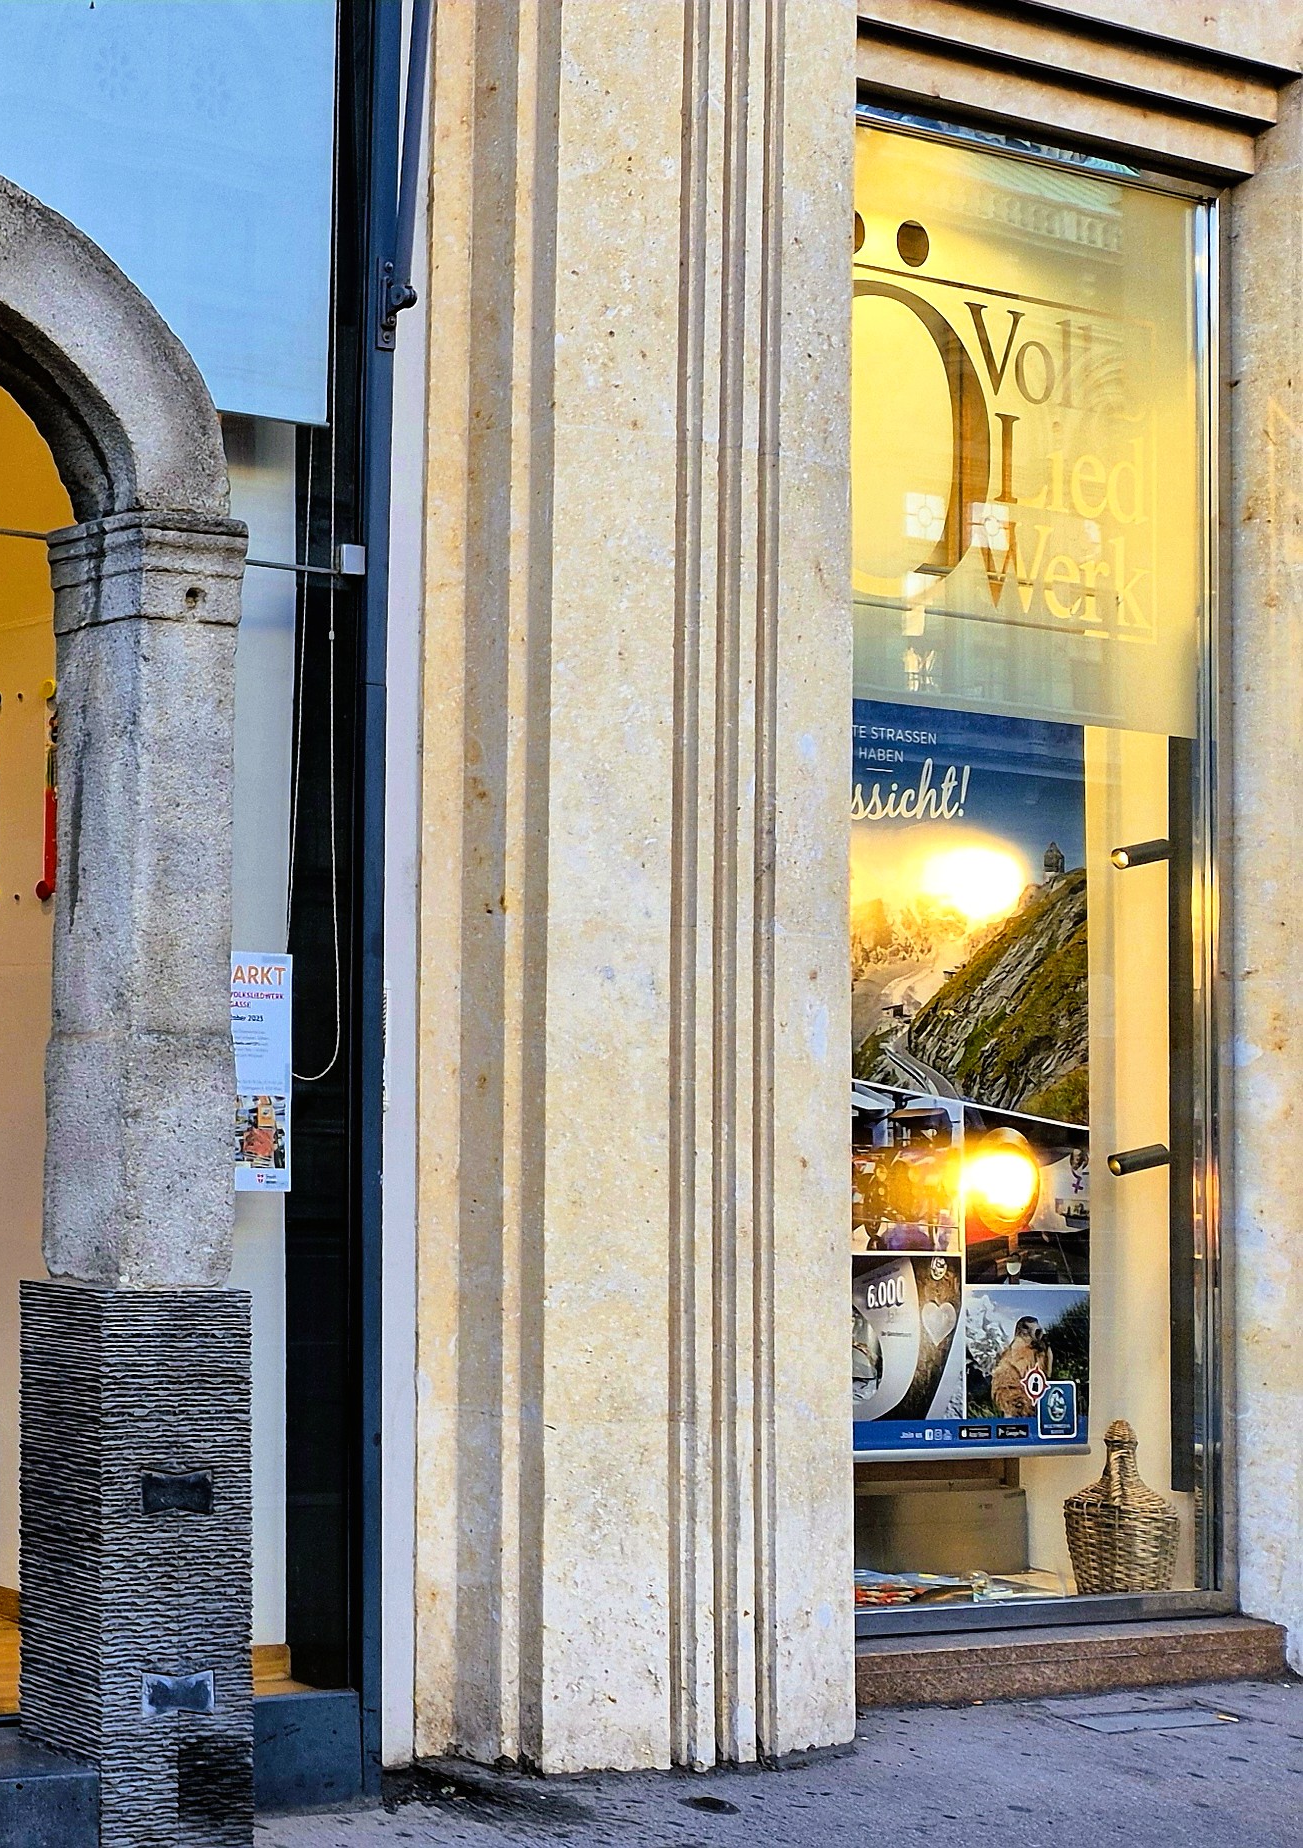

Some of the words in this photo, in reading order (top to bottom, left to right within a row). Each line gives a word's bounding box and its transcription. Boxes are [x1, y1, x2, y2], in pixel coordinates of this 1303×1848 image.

[993, 410, 1149, 526] Lied
[975, 515, 1155, 628] Werk
[859, 748, 904, 763] HABEN
[870, 727, 937, 746] STRASSEN
[851, 757, 971, 820] ssicht!
[867, 1275, 906, 1308] 6.000
